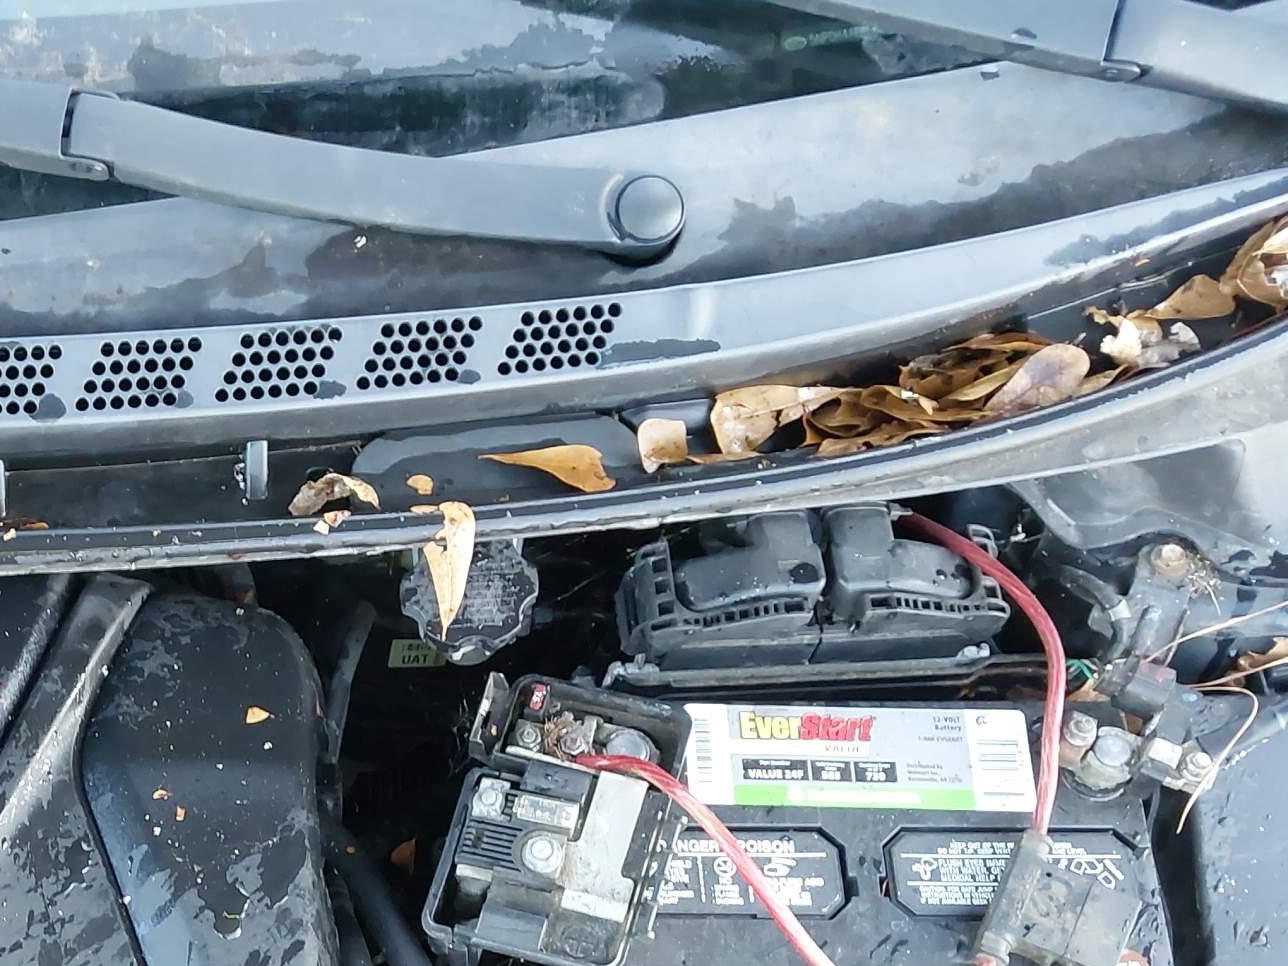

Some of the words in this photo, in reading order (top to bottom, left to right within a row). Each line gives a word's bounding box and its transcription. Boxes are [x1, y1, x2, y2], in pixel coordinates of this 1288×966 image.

[738, 710, 873, 742] EverStart
[934, 724, 962, 733] Battery
[748, 768, 783, 779] VALUE
